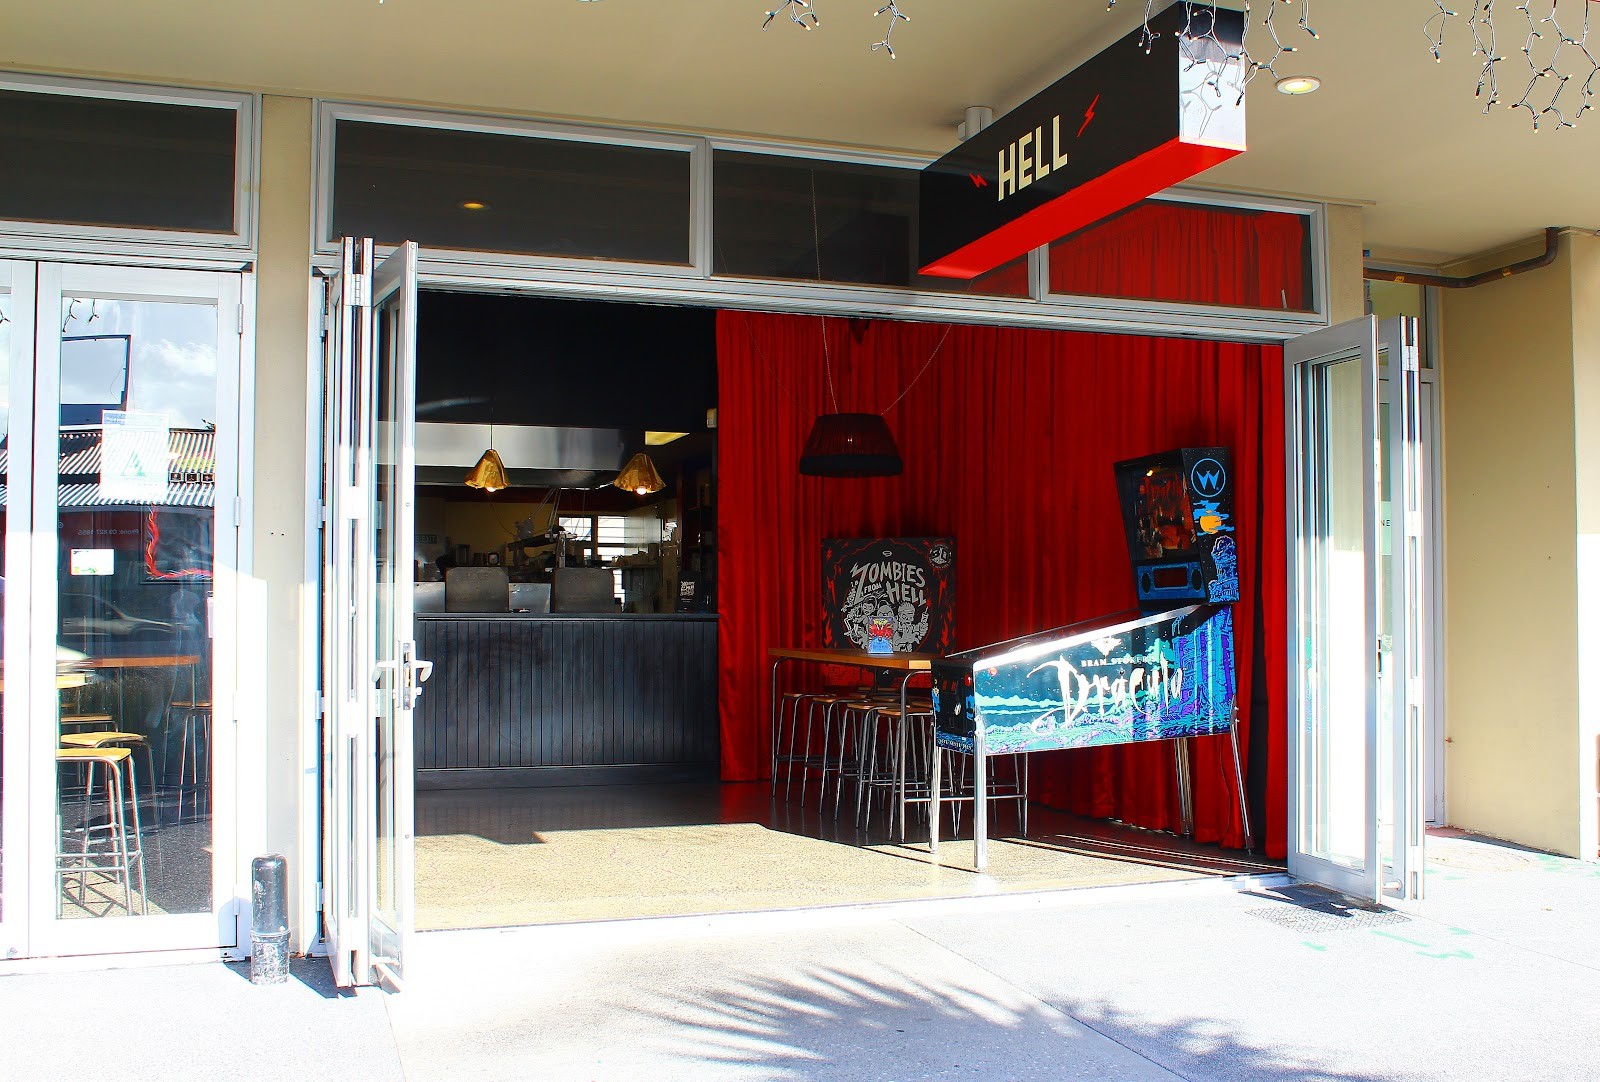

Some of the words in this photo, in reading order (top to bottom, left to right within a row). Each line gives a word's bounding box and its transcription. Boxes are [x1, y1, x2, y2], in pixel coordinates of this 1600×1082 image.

[998, 115, 1068, 202] HELL
[849, 561, 926, 606] ZOMBIES
[864, 583, 883, 594] FROM
[885, 580, 927, 607] HELL
[1081, 658, 1107, 667] BRAM
